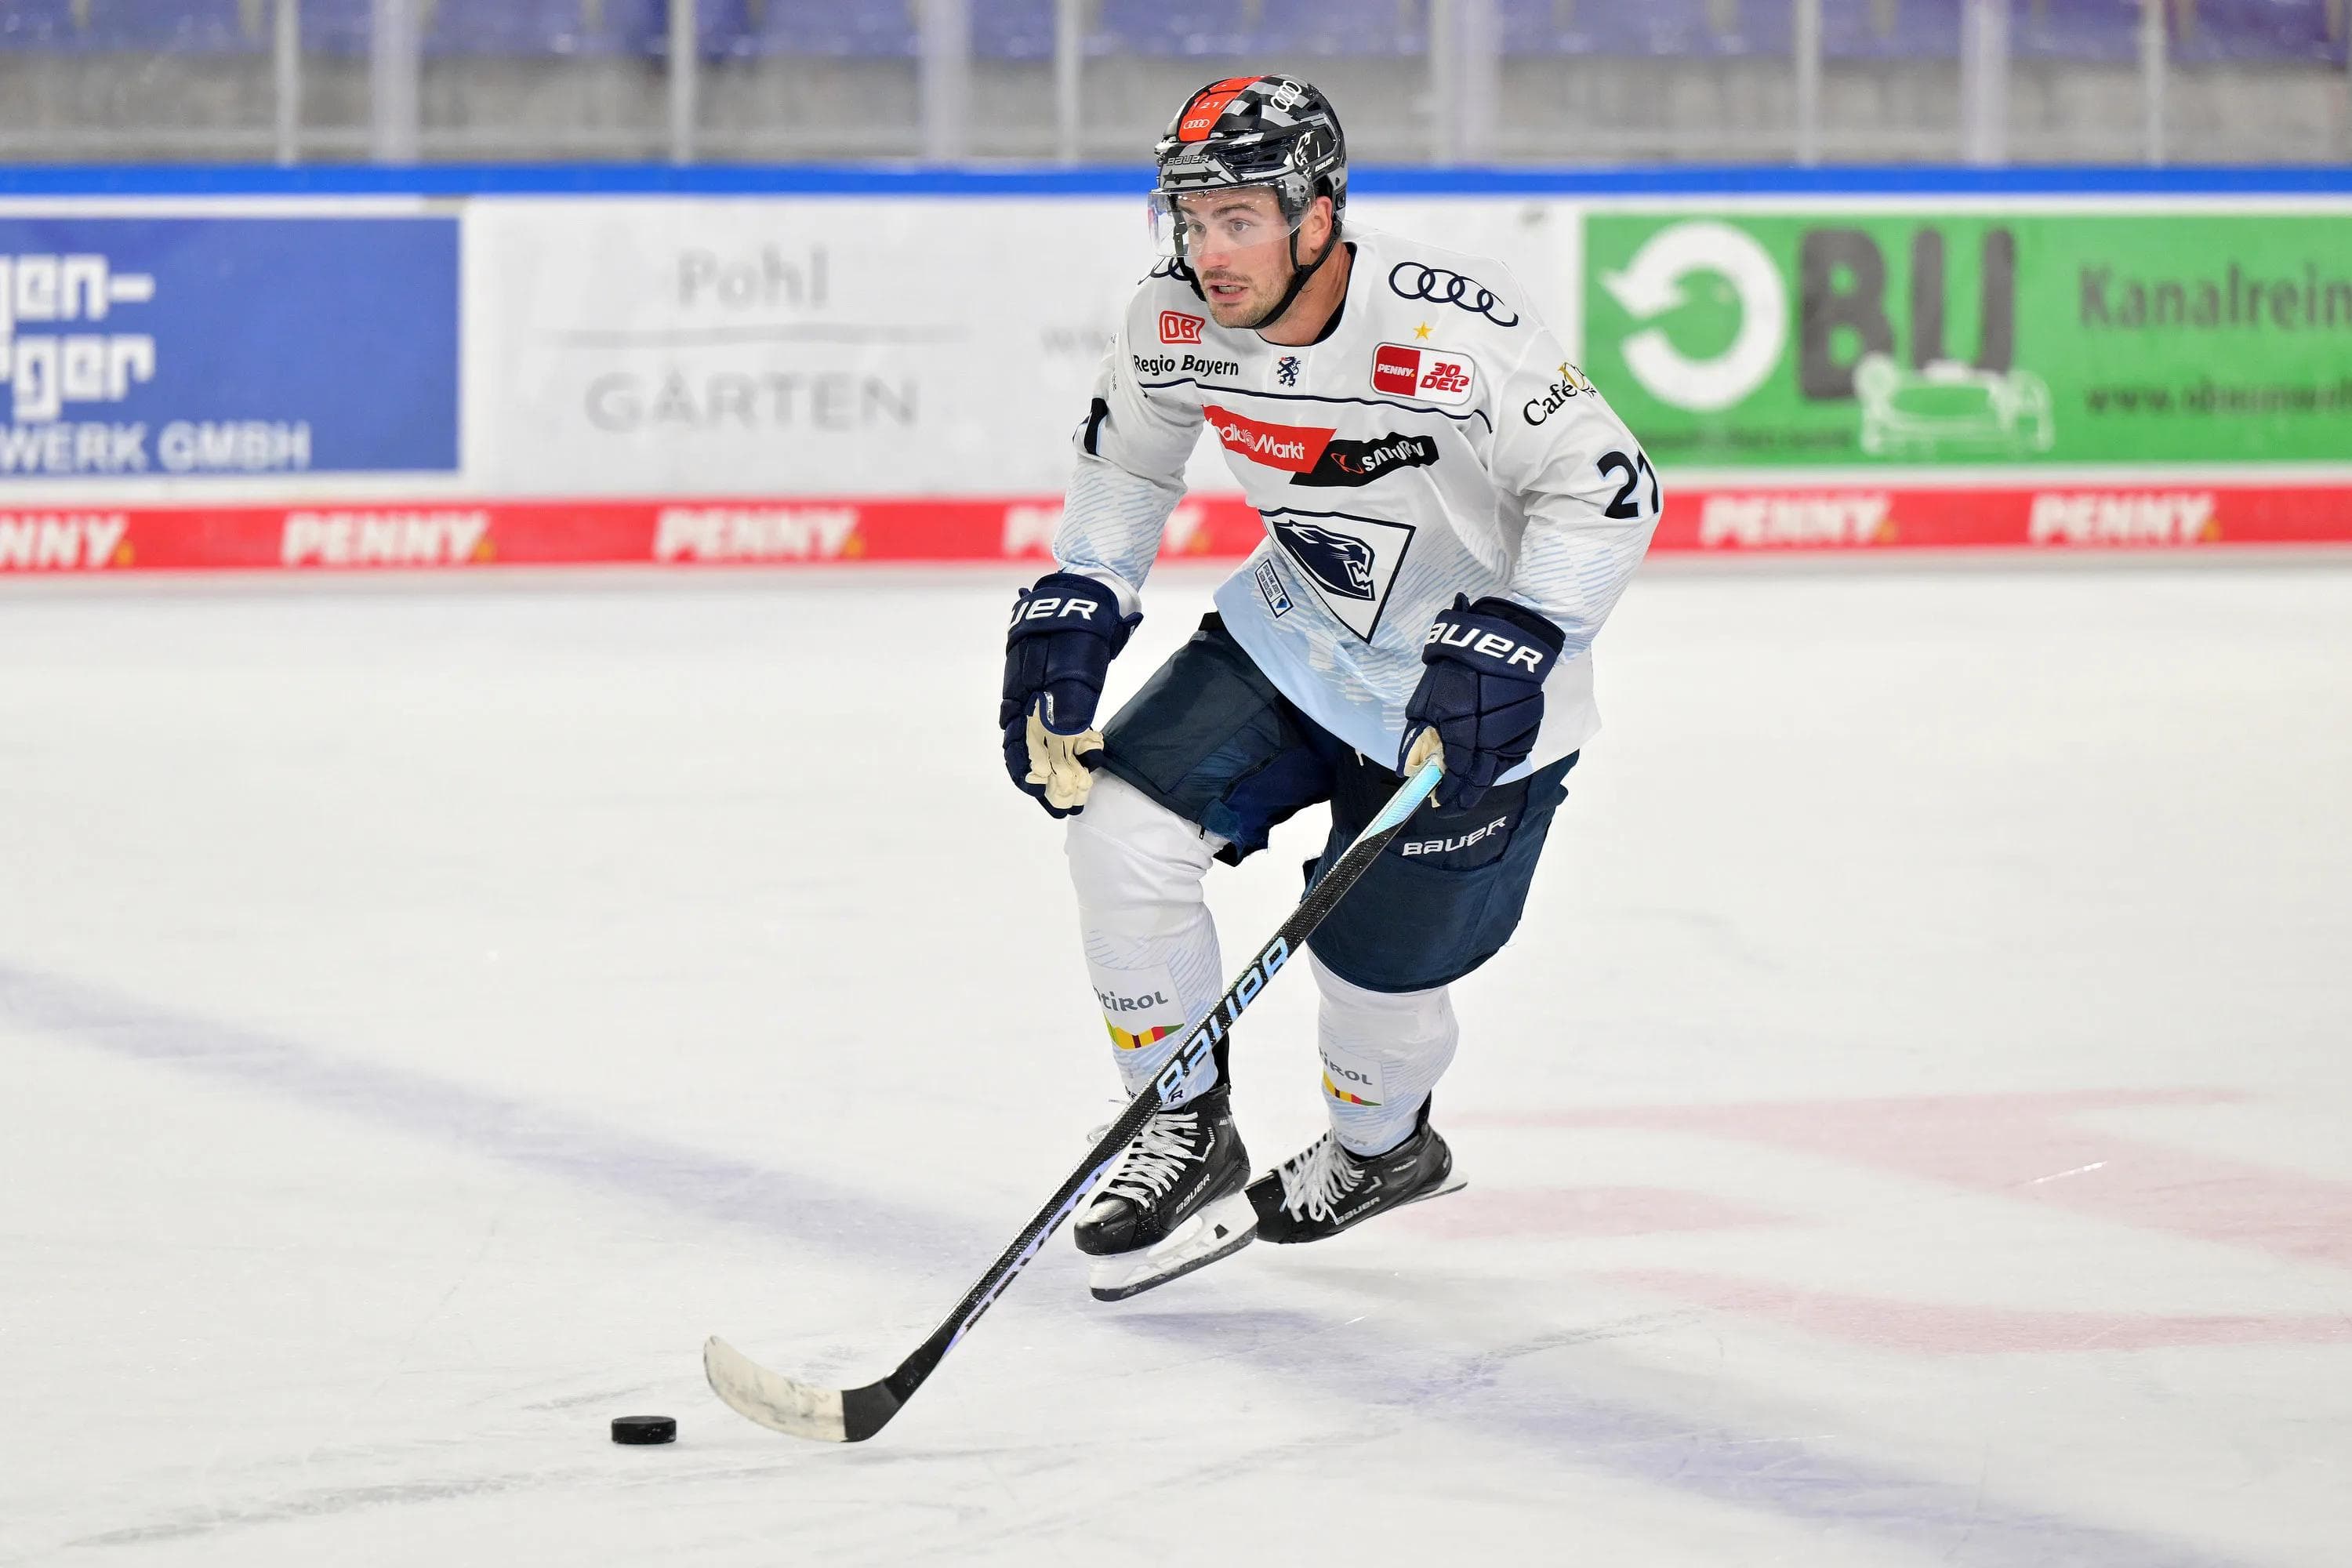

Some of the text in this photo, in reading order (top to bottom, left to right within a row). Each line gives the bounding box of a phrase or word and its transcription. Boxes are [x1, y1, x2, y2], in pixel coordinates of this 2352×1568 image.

[1167, 154, 1210, 165] BAUER
[677, 246, 829, 307] Pohl
[1164, 316, 1197, 339] DB
[1133, 354, 1239, 377] Regio Bayern
[1430, 362, 1461, 378] 30
[1523, 379, 1577, 426] Café
[1362, 441, 1425, 472] SATURN
[1596, 450, 1659, 519] 21
[1425, 622, 1544, 673] AUER
[1402, 816, 1507, 856] BAUER
[1176, 1174, 1210, 1214] BAUER
[1335, 1196, 1380, 1225] BAUER
